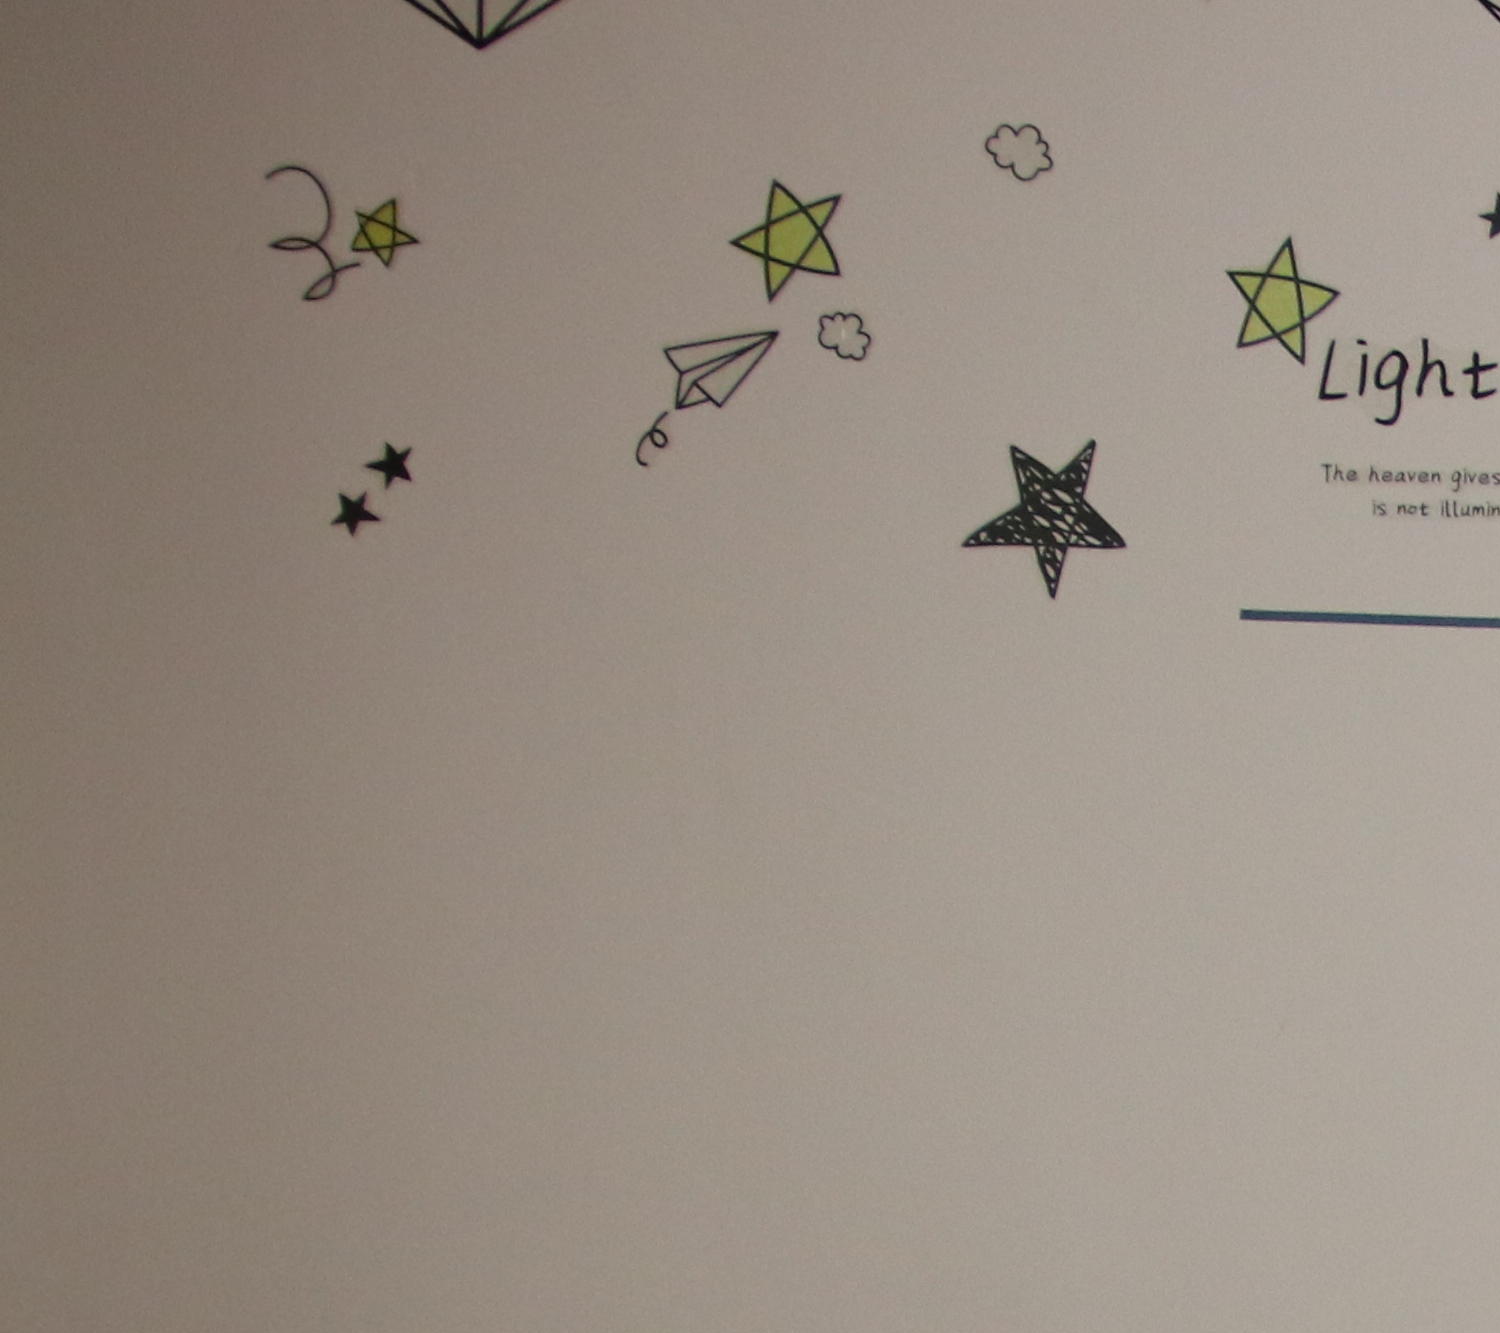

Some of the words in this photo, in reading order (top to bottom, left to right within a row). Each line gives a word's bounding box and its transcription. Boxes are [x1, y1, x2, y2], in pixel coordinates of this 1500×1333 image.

[1317, 337, 1499, 427] Light
[1320, 462, 1359, 484] The
[1367, 465, 1442, 485] heaven
[1372, 499, 1388, 517] is
[1396, 501, 1430, 518] not
